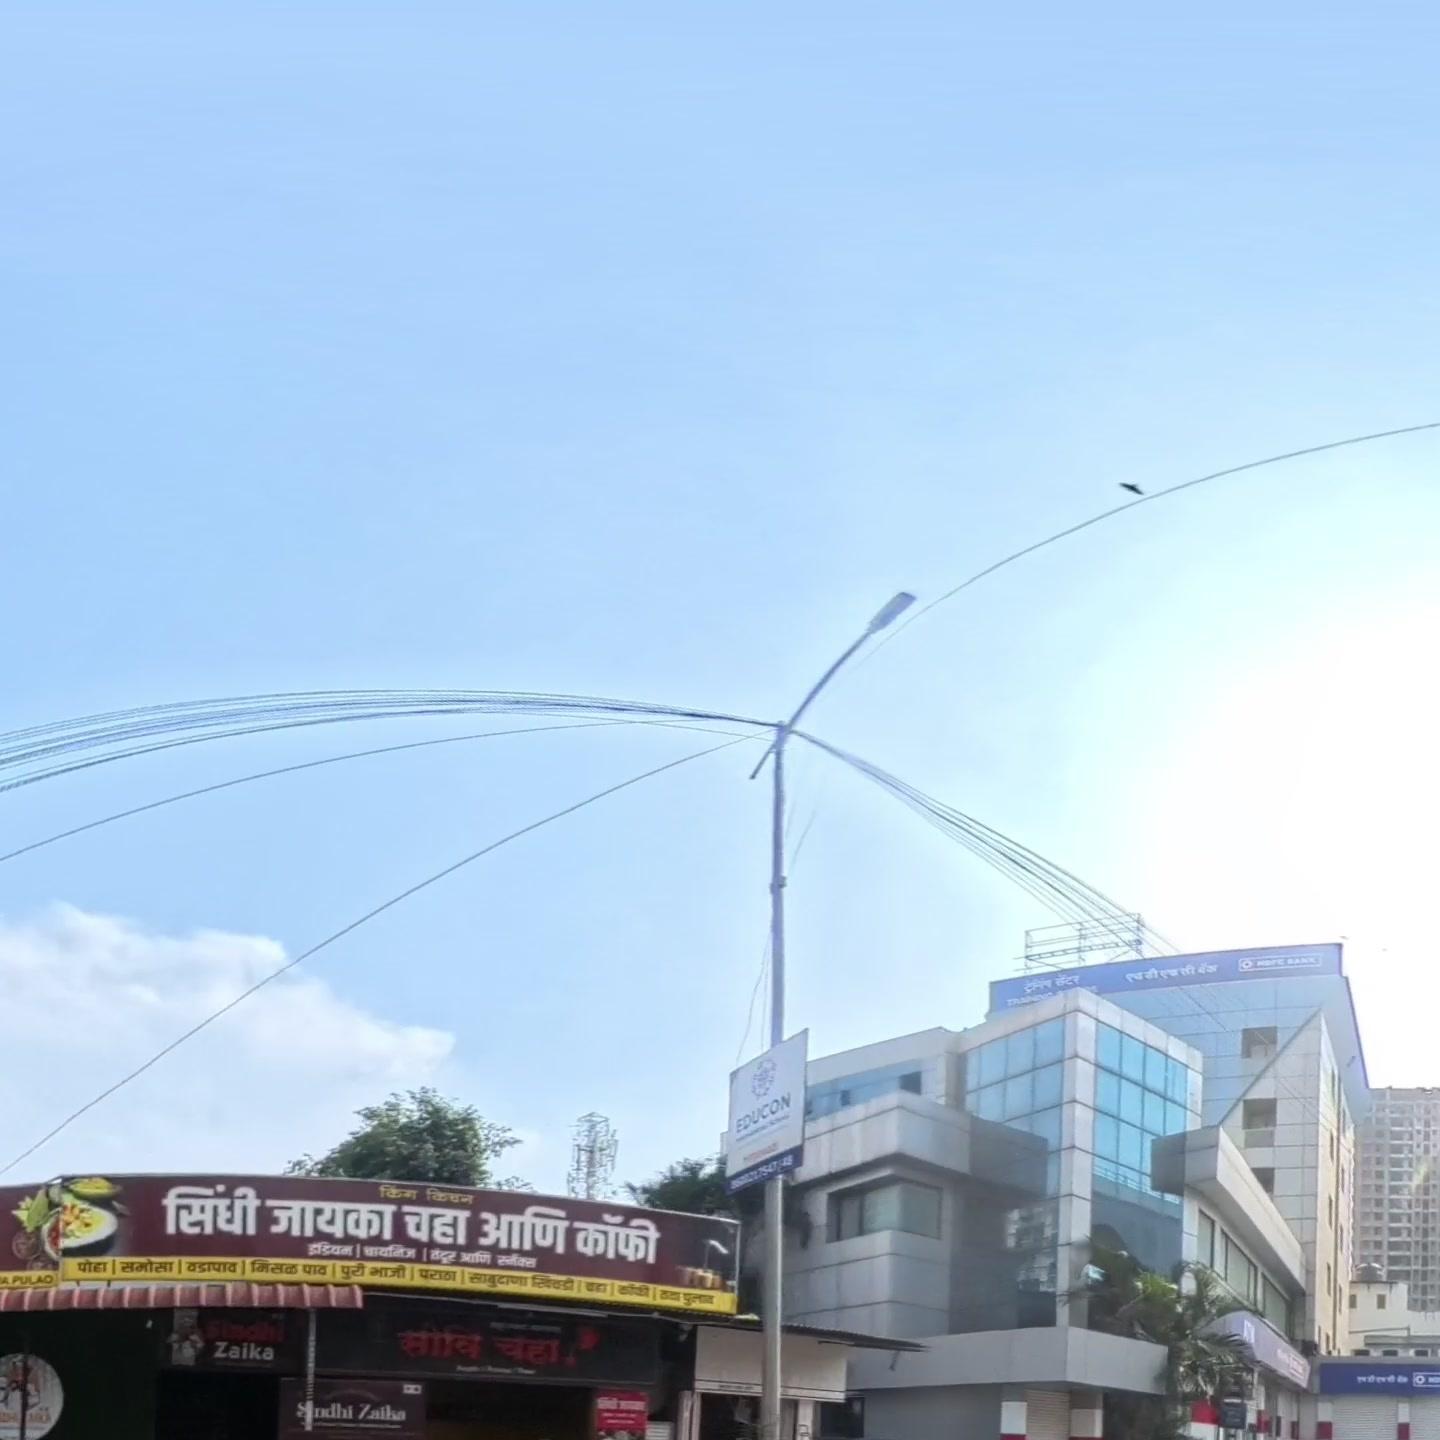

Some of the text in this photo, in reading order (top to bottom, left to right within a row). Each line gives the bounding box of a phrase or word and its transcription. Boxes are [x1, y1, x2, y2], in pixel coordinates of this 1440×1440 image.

[1287, 956, 1317, 965] BANK
[736, 1092, 791, 1133] EDUCON
[163, 1184, 661, 1264] सिंधी जायका चहा आणि कॉफी
[77, 1260, 109, 1274] पोहा
[119, 1260, 174, 1275] समोसा
[186, 1260, 238, 1275] वडापाव
[302, 1262, 328, 1276] पाव
[12, 1274, 54, 1285] PULAO
[213, 1341, 276, 1361] Zaika
[296, 1401, 406, 1421] Sndhi Zaika
